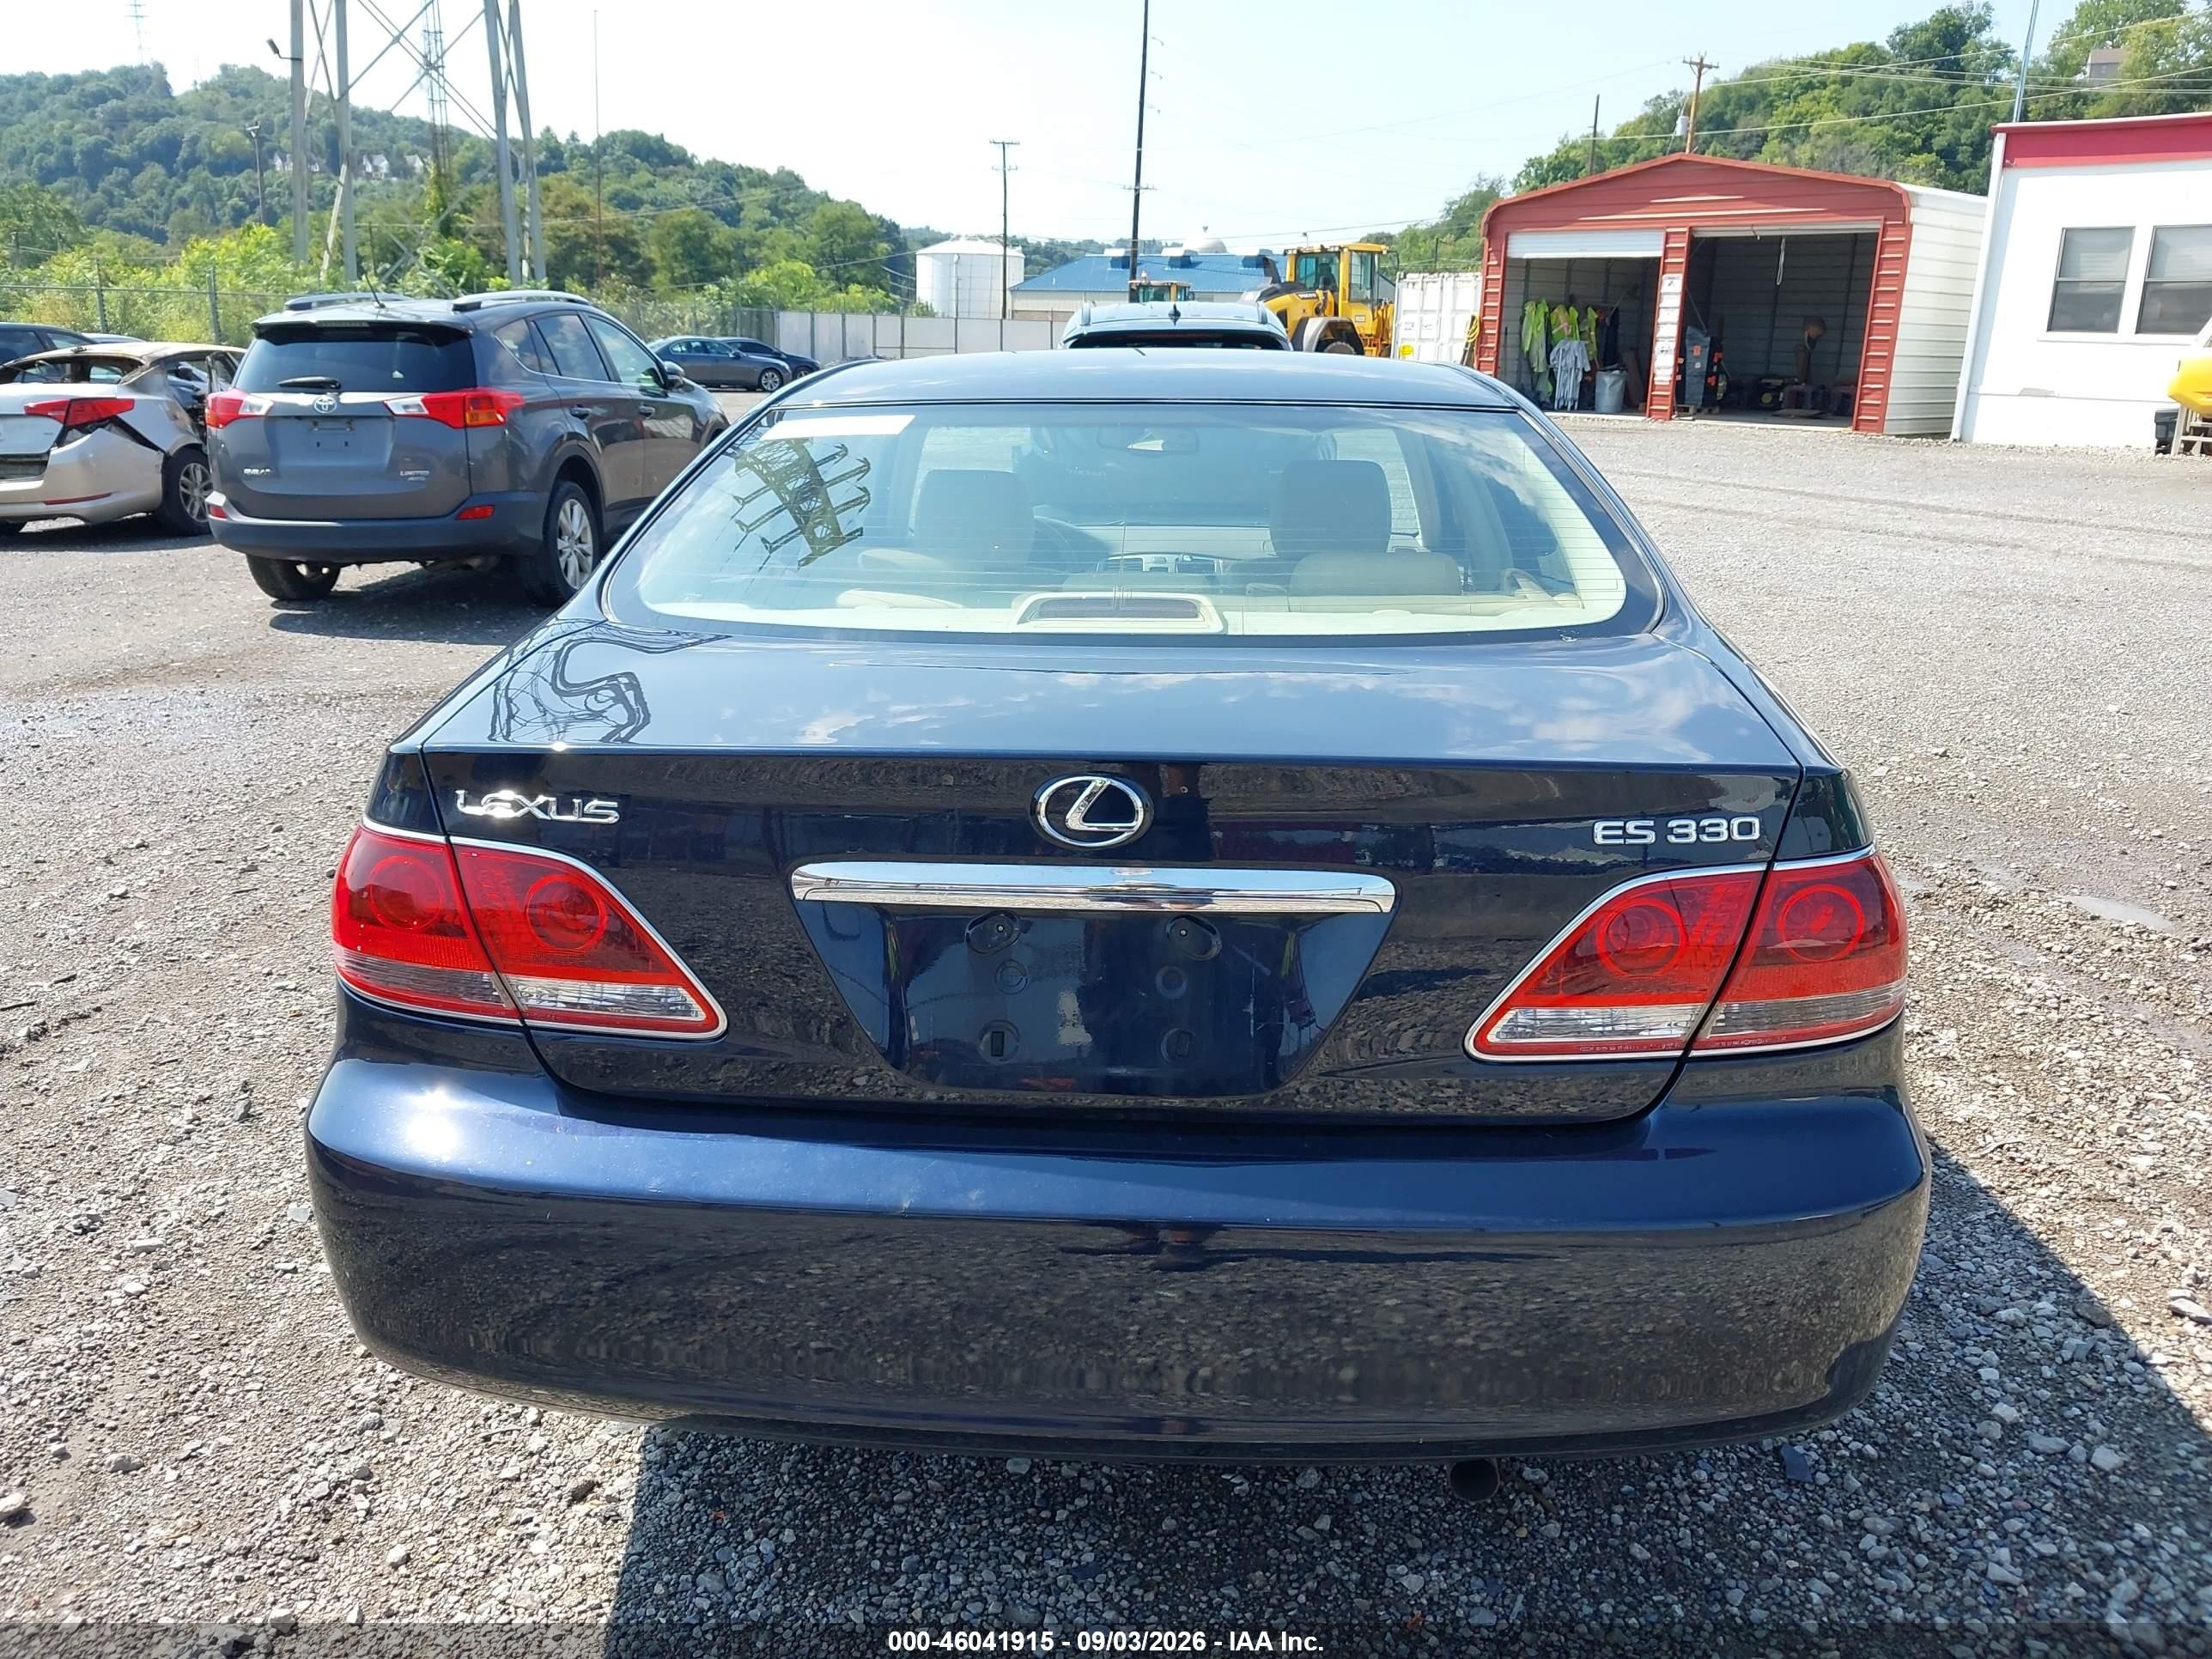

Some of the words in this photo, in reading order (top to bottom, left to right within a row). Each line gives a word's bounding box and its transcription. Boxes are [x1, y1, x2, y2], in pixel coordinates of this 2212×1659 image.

[454, 789, 621, 824] LEXUS
[1593, 820, 1656, 845] ES
[1666, 816, 1760, 844] 330
